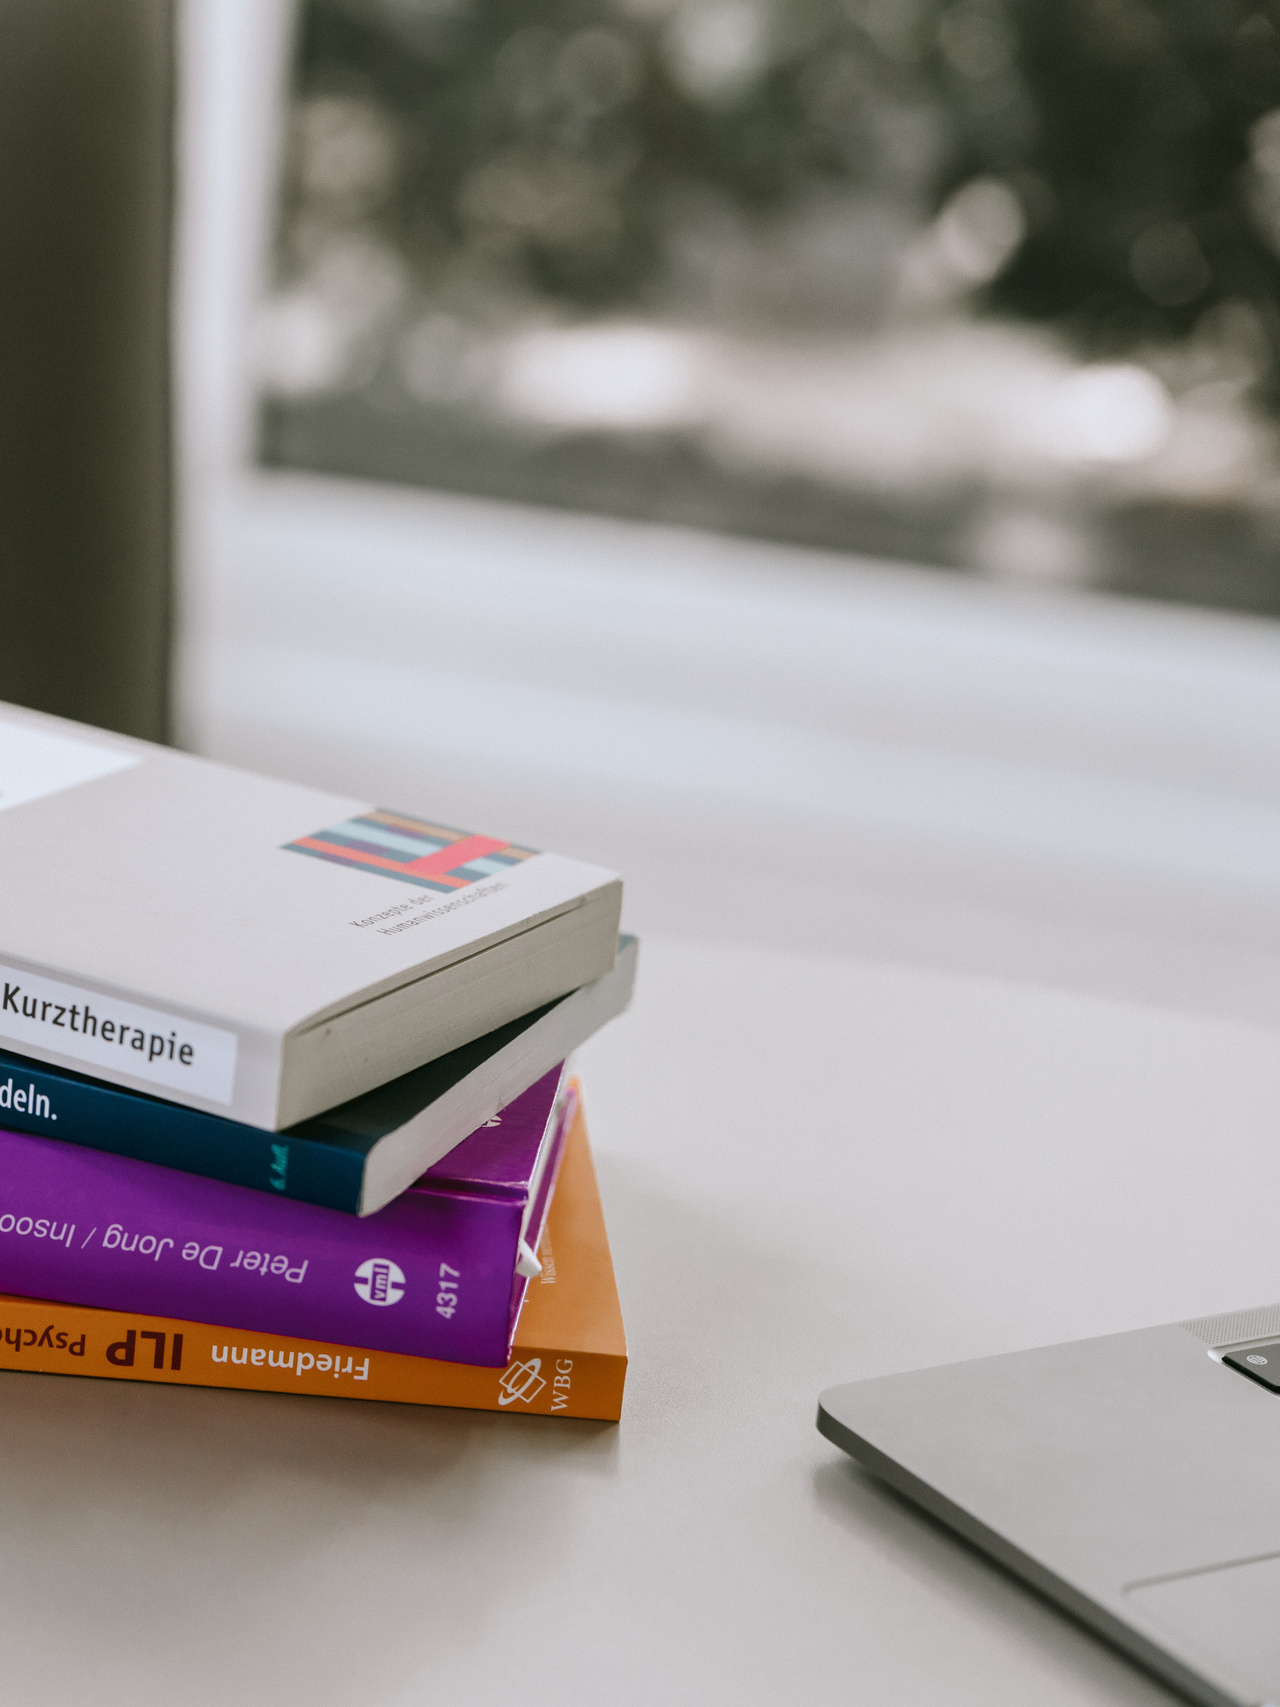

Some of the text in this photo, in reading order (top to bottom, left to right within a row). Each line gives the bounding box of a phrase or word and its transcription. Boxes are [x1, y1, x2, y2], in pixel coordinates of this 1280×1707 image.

[348, 894, 434, 928] Konzepte der
[2, 983, 194, 1066] Kurztherapie
[102, 1223, 174, 1261] Jong
[181, 1241, 224, 1270] De
[230, 1249, 309, 1284] Peter
[374, 1266, 390, 1300] vml
[435, 1262, 460, 1319] 4317
[106, 1329, 183, 1371] ILP
[211, 1345, 370, 1381] Friedmann
[551, 1358, 573, 1411] WBG
